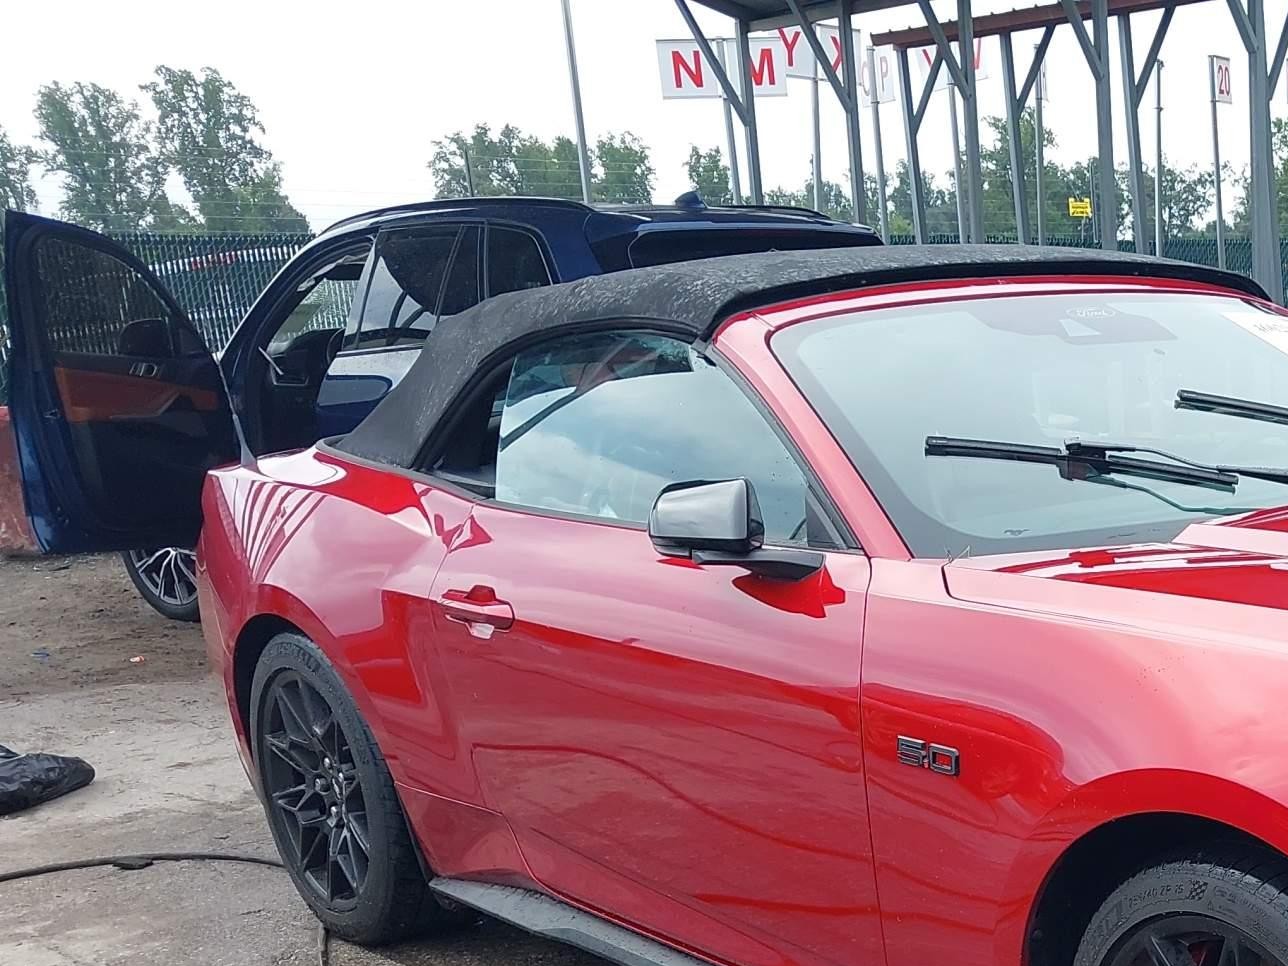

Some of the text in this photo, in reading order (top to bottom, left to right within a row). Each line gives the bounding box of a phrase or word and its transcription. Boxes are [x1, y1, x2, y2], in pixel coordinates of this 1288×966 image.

[778, 27, 800, 67] Y
[671, 50, 703, 88] N
[750, 48, 776, 85] M
[1217, 64, 1230, 97] 20
[897, 734, 960, 776] 5.0
